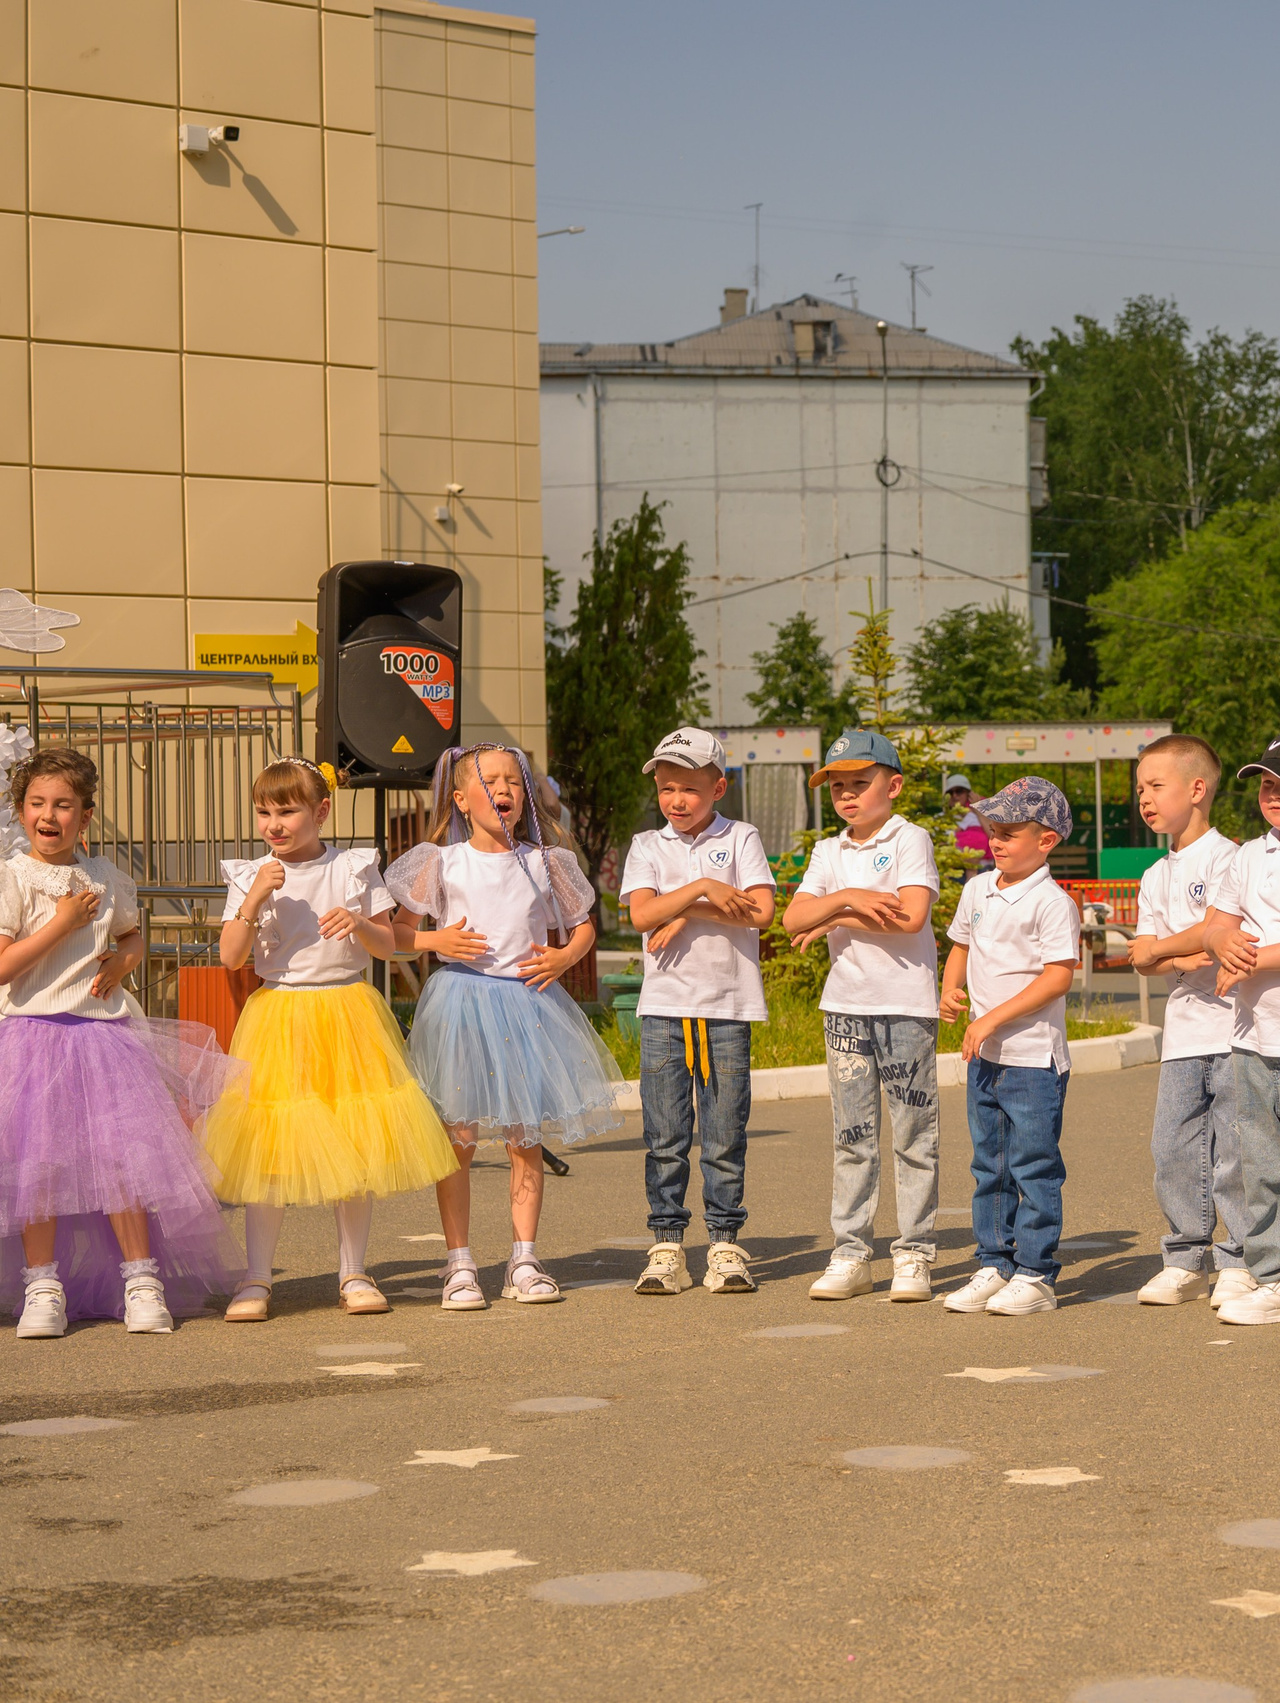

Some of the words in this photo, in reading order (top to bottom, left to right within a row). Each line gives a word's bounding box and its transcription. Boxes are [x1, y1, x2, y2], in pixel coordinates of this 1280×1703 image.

[200, 651, 299, 666] ЦЕНТРАЛЬНЫЙ
[302, 654, 318, 665] ВХ
[381, 652, 440, 674] 1000
[406, 673, 433, 681] WATTS
[422, 684, 450, 699] MP3
[827, 1013, 861, 1037] BEST
[878, 1061, 910, 1084] ROCK
